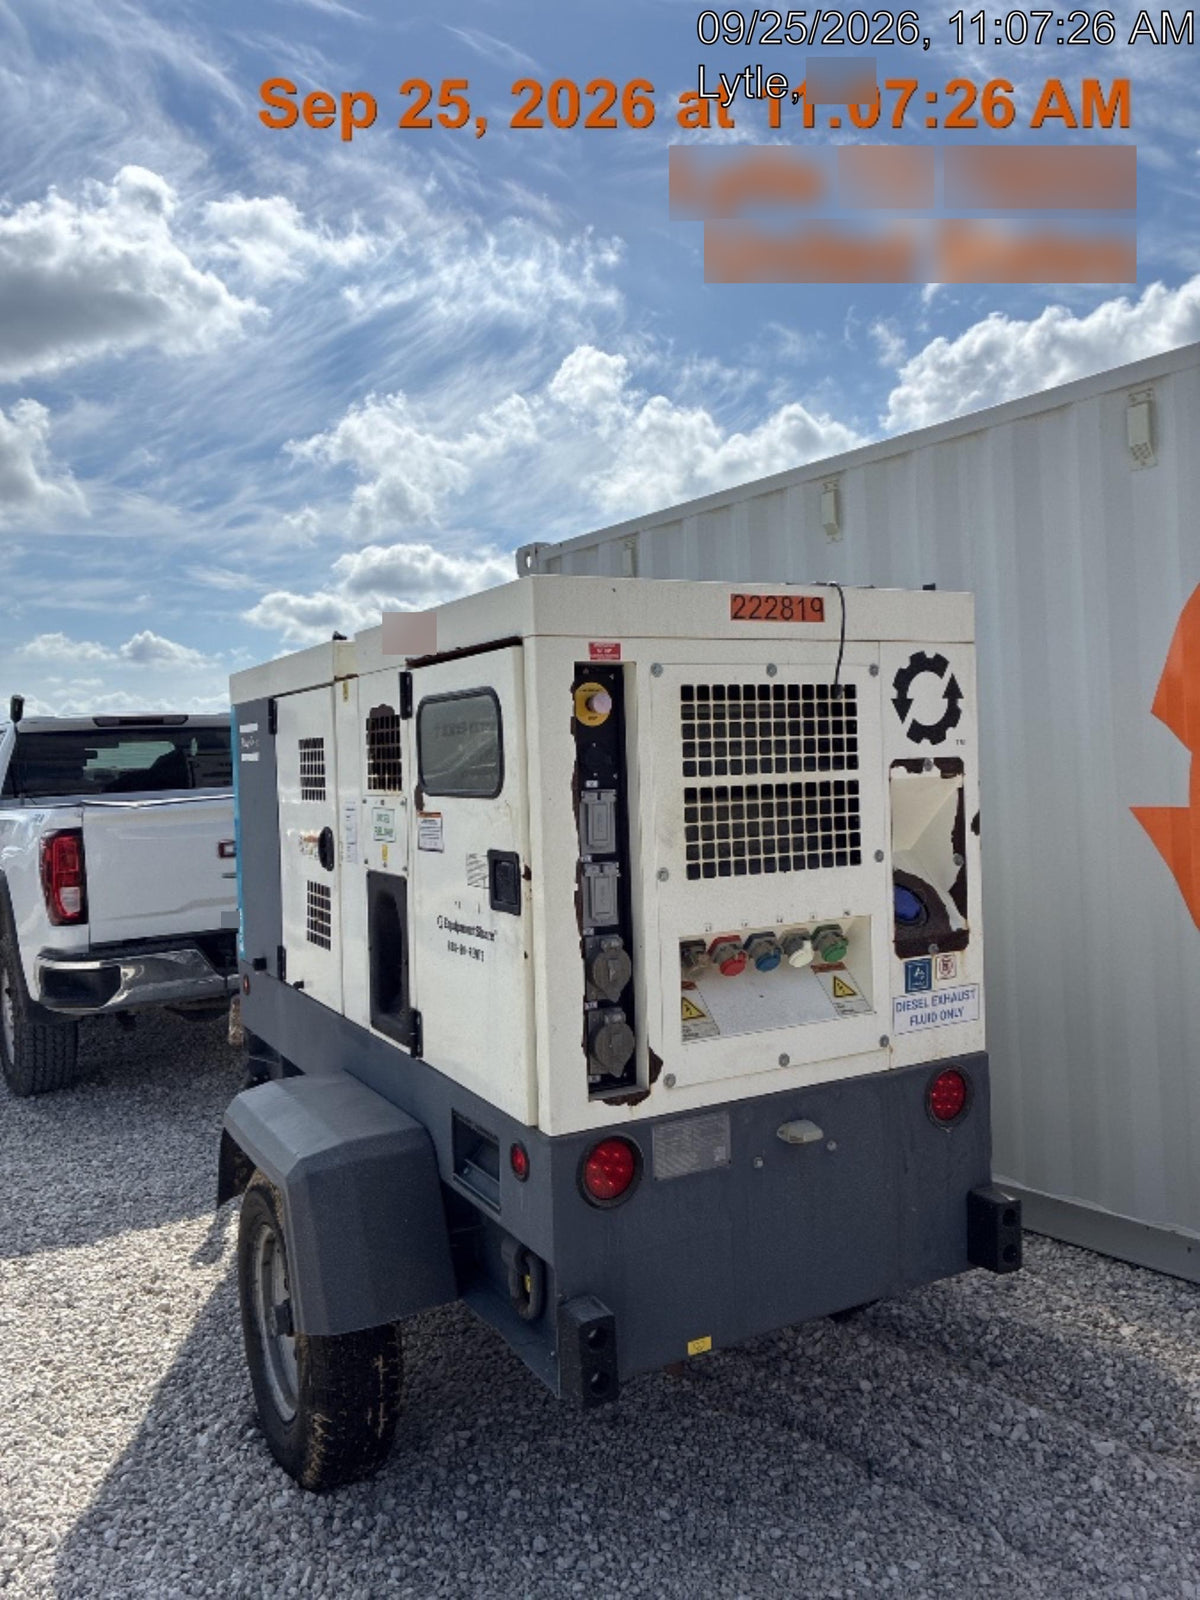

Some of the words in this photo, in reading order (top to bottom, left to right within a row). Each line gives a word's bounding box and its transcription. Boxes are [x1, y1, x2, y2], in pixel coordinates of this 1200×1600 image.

[732, 594, 824, 621] 222819
[895, 997, 929, 1012] DIESEL
[931, 988, 976, 1007] EXHAUST
[909, 1011, 938, 1026] FLUID
[940, 1006, 965, 1021] ONLY
